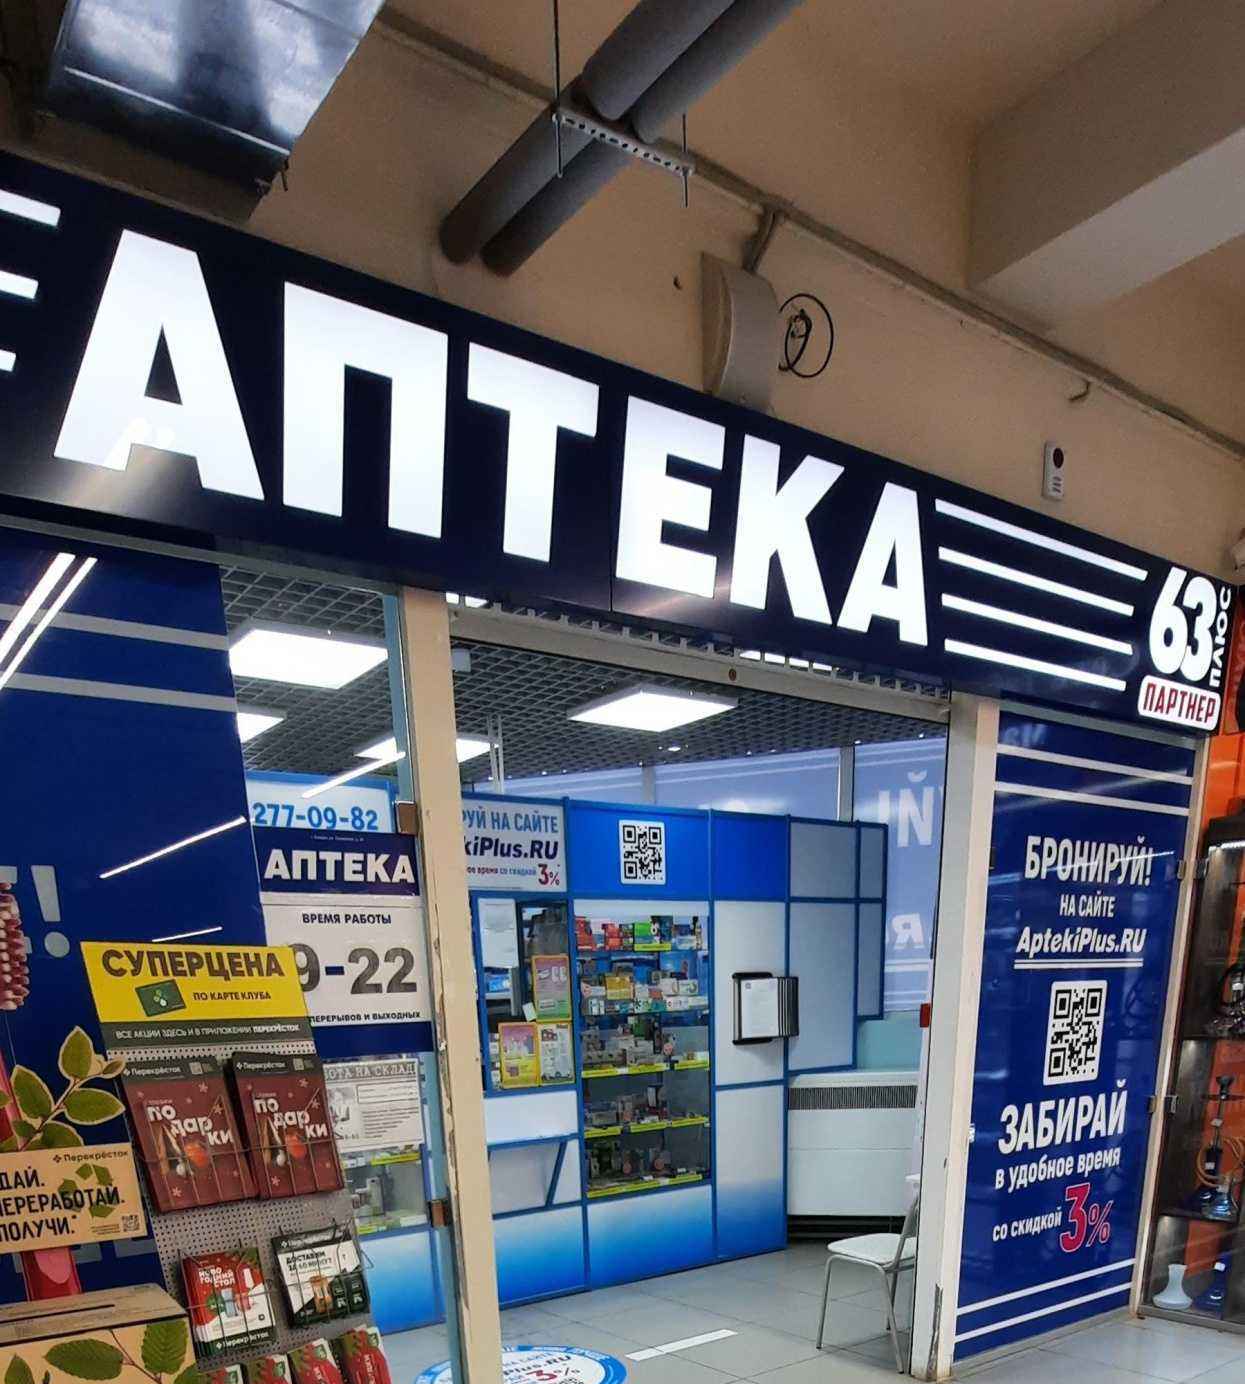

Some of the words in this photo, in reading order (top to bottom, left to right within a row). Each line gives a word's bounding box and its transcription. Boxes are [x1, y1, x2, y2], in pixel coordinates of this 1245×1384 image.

[54, 229, 928, 647] АПТЕКА
[1150, 566, 1217, 682] 63
[1209, 586, 1231, 688] ПЛЮС
[1143, 682, 1216, 723] ПАРТНЕР
[252, 803, 379, 831] 277-09-82
[491, 811, 511, 831] НА
[514, 810, 559, 833] САЙТЕ
[264, 849, 416, 884] АПТЕКА
[1024, 835, 1154, 887] БРОНИРУЙ!
[1060, 894, 1076, 917] НА
[1079, 891, 1116, 918] САЙТЕ
[302, 914, 341, 925] ВРЕМЯ
[344, 914, 392, 925] РАБОТЫ
[1016, 926, 1147, 958] AptekiPlus.RU
[102, 949, 286, 981] СУПЕРЦЕНА
[193, 992, 208, 1001] ПО
[210, 991, 240, 1001] КАРТЕ
[241, 991, 272, 1001] КЛУБА
[364, 1013, 371, 1021] И
[372, 1010, 421, 1020] ВЫХОДНЫХ
[115, 1030, 133, 1040] ВСЕ
[134, 1028, 161, 1038] АКЦИИ
[162, 1027, 187, 1038] ЗДЕСЬ
[202, 1024, 252, 1036] ПРИЛОЖЕНИИ
[355, 1064, 373, 1078] НА
[146, 1104, 177, 1122] по
[254, 1098, 279, 1115] по
[998, 1079, 1128, 1155] ЗАБИРАЙ
[170, 1115, 213, 1138] дар
[273, 1111, 311, 1129] дар
[305, 1122, 328, 1138] ки
[207, 1127, 235, 1146] ки
[64, 1151, 129, 1163] Перекрёсток
[995, 1168, 1005, 1190] в
[1008, 1154, 1073, 1194] удобное
[1077, 1147, 1121, 1178] время
[992, 1223, 1008, 1242] со
[1011, 1206, 1063, 1237] скидкой
[1060, 1182, 1115, 1253] 3%
